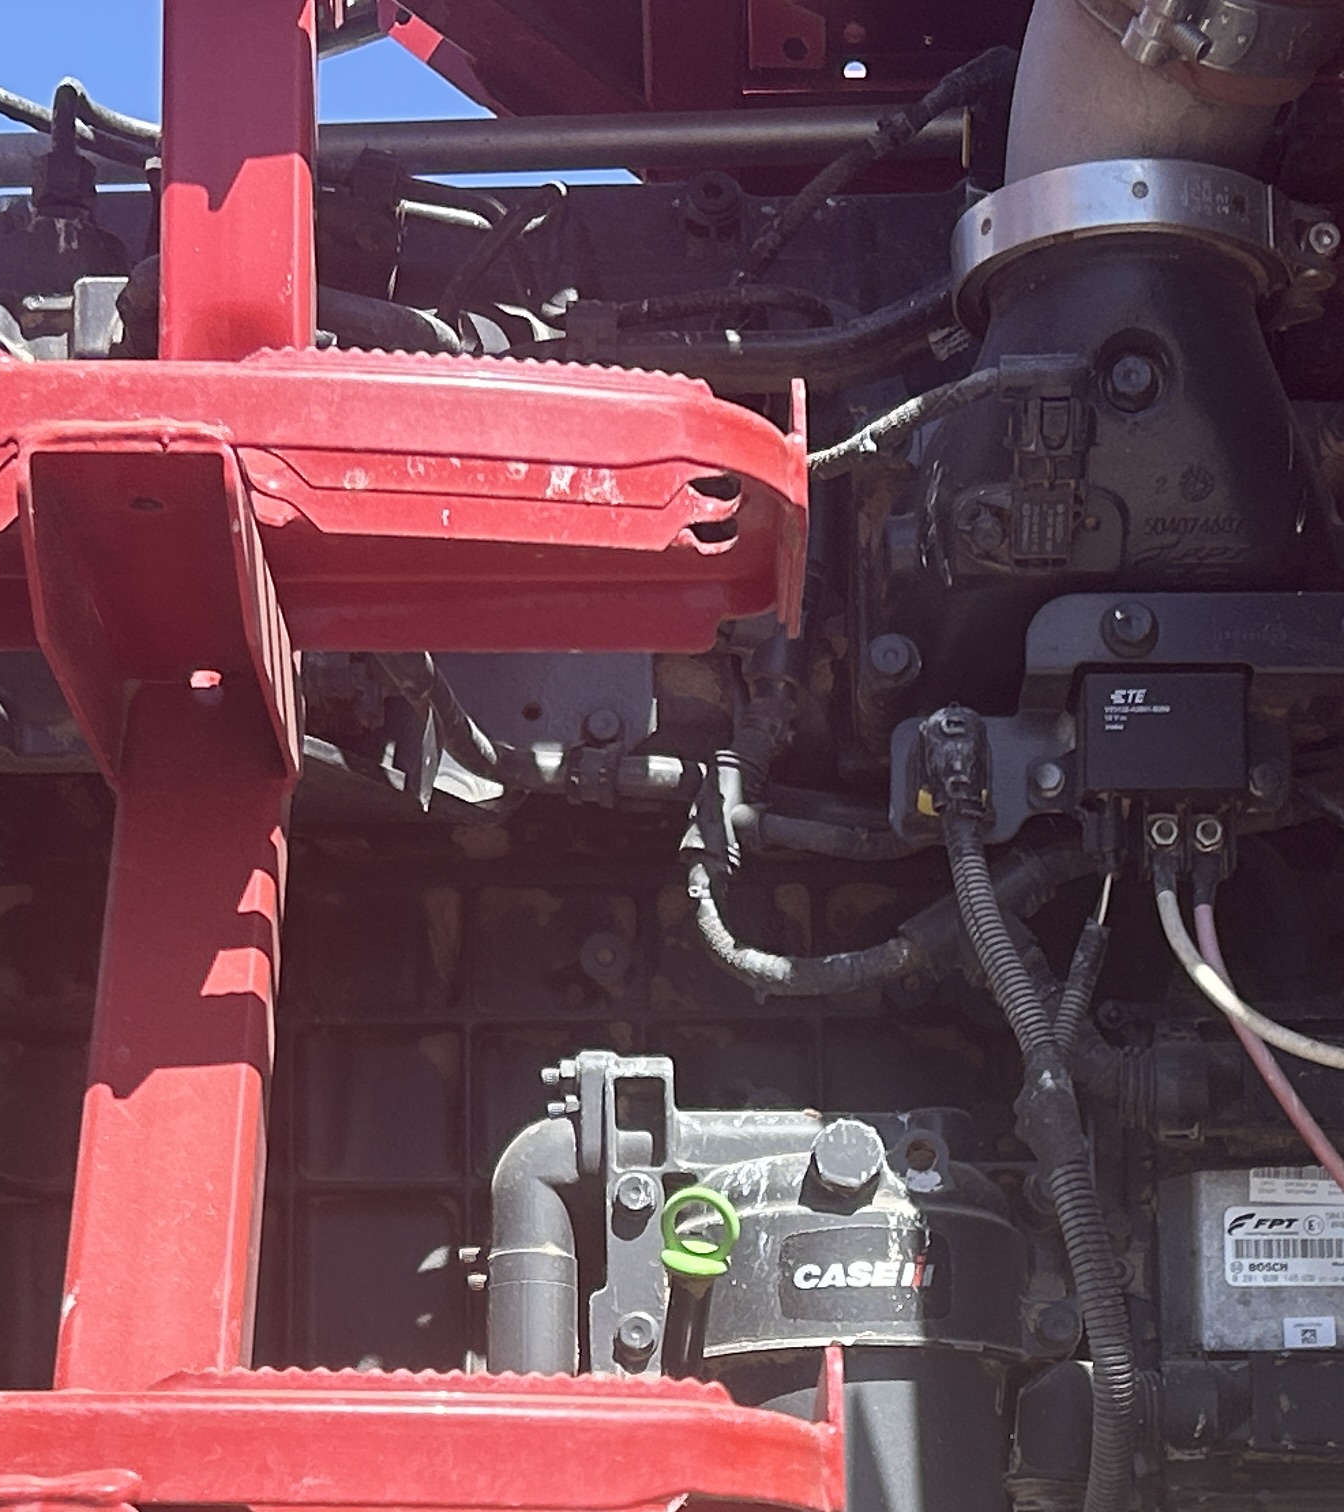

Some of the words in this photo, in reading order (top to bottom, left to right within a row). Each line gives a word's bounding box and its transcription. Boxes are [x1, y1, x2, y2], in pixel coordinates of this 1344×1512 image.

[1253, 1218, 1299, 1229] FPT
[1249, 1262, 1288, 1272] BOSCH
[792, 1261, 900, 1289] CASE
